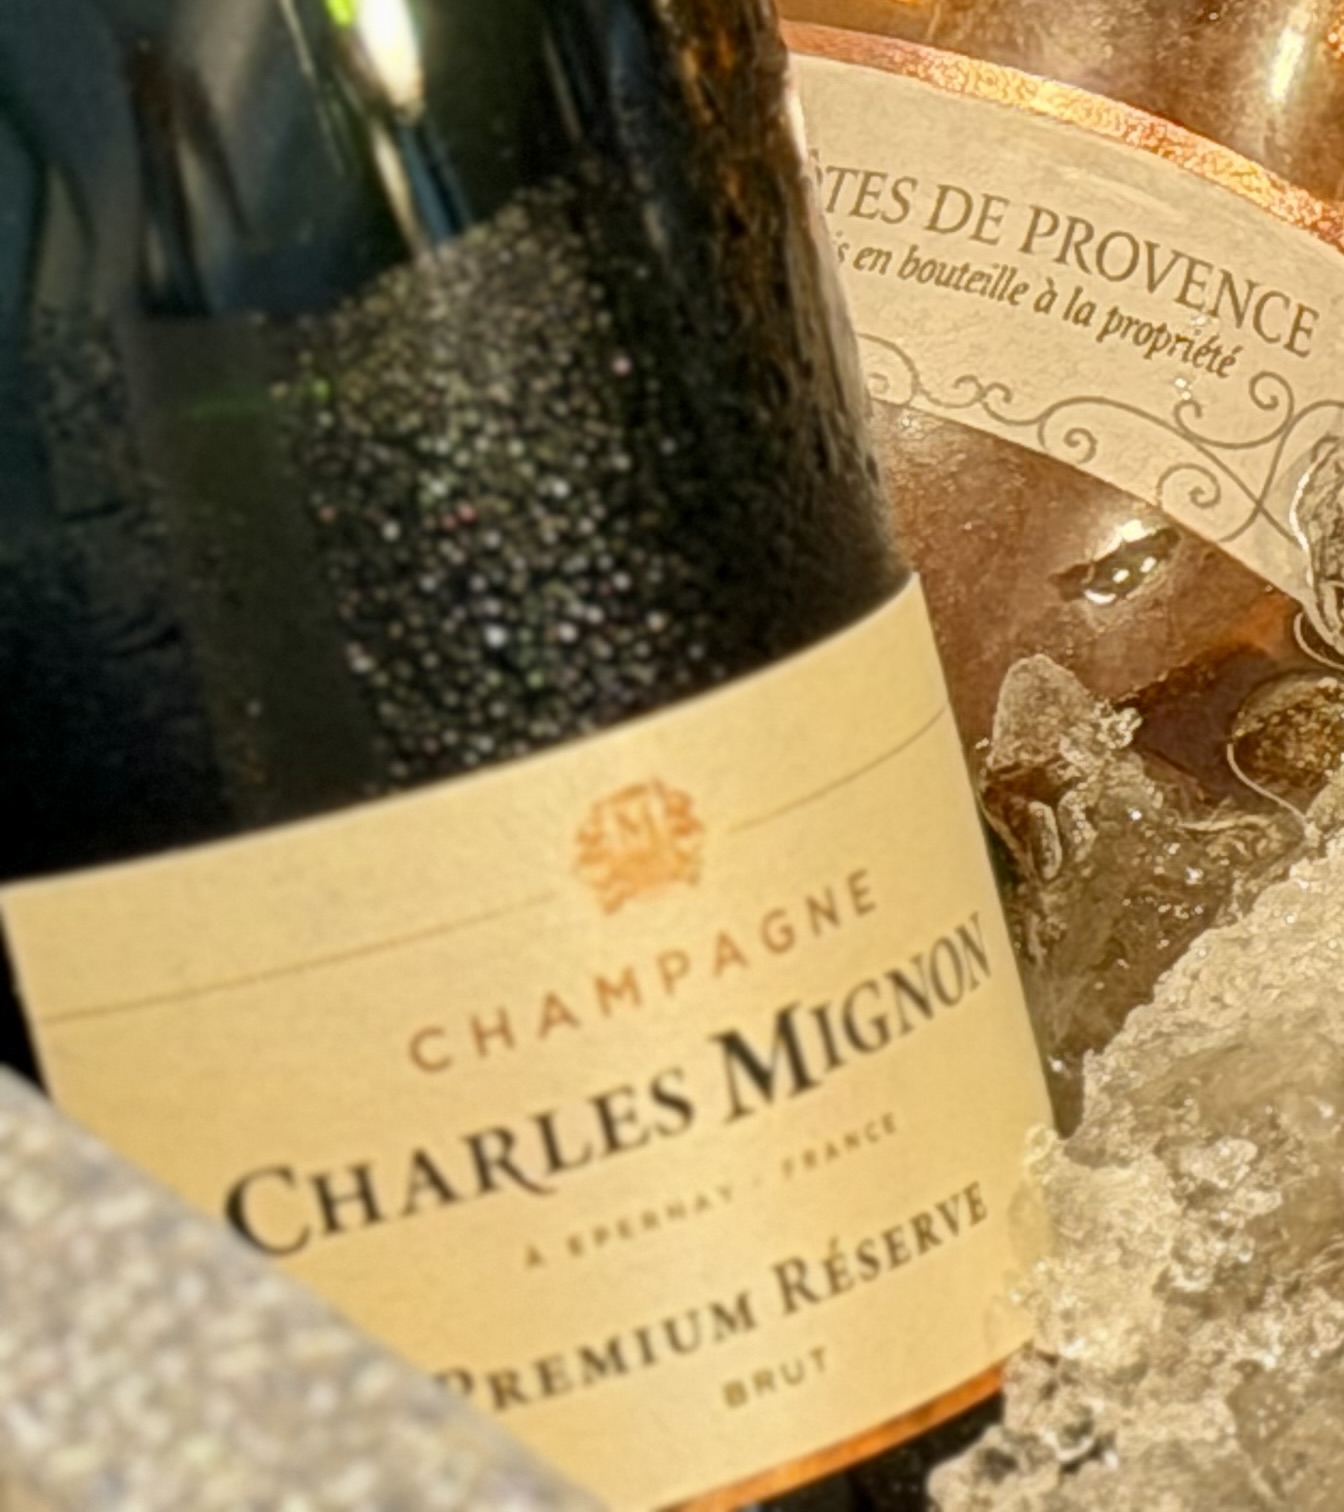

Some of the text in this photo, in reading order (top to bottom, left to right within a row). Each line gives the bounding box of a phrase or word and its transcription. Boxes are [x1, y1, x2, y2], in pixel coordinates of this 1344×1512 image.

[809, 149, 1320, 358] TES DE PROVENCE
[853, 246, 893, 276] en
[898, 244, 1030, 306] bouteille
[1033, 280, 1059, 314] à
[1062, 285, 1098, 329] la
[1098, 304, 1246, 380] propriété
[407, 869, 879, 1074] CHAMPAGNE
[224, 913, 993, 1258] CHARLES MIGNON
[781, 1112, 898, 1178] FRANCE
[434, 1181, 989, 1413] PREMIUM RÉSERVE
[722, 1347, 831, 1409] BRUT
